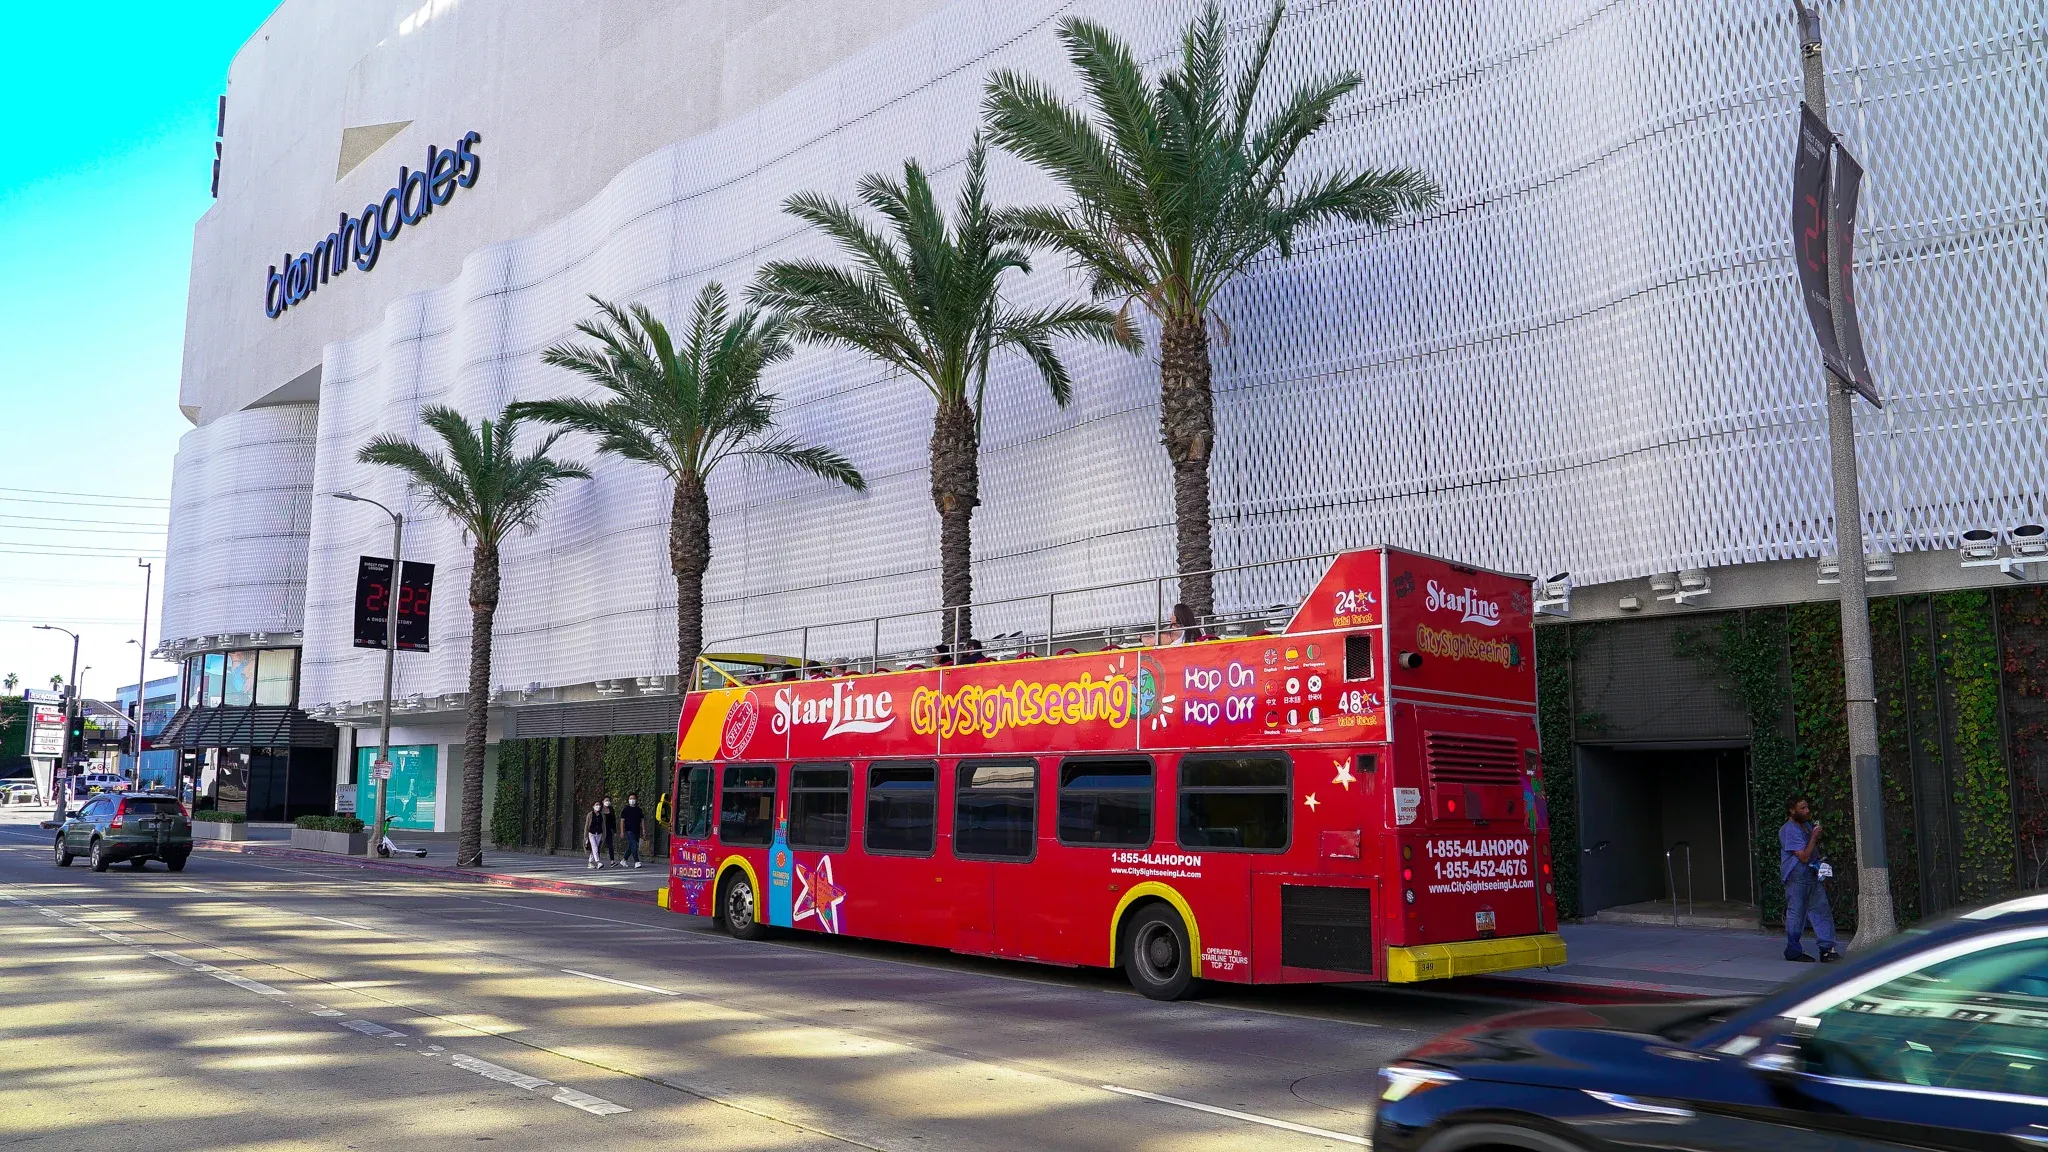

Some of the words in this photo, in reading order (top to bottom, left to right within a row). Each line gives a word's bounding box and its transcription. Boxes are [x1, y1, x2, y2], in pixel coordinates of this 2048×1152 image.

[1335, 590, 1357, 615] 24
[1184, 667, 1222, 693] Hop
[1228, 662, 1255, 688] On
[1265, 697, 1277, 706] 中文
[1338, 690, 1361, 714] 48
[1184, 699, 1220, 726] Hop
[1226, 694, 1256, 721] Off
[1111, 851, 1202, 867] 1-855-4LAHOPON
[1110, 867, 1202, 879] www.CitySightseeingLA.com
[1434, 858, 1528, 880] 1-855-452-4676
[1428, 878, 1534, 895] www.CitySightseeingLA.com
[1201, 953, 1227, 963] STARLINE
[1228, 956, 1249, 965] TOURS
[1206, 947, 1232, 956] OPERATED
[1210, 961, 1223, 970] TCP
[1223, 962, 1235, 970] 227
